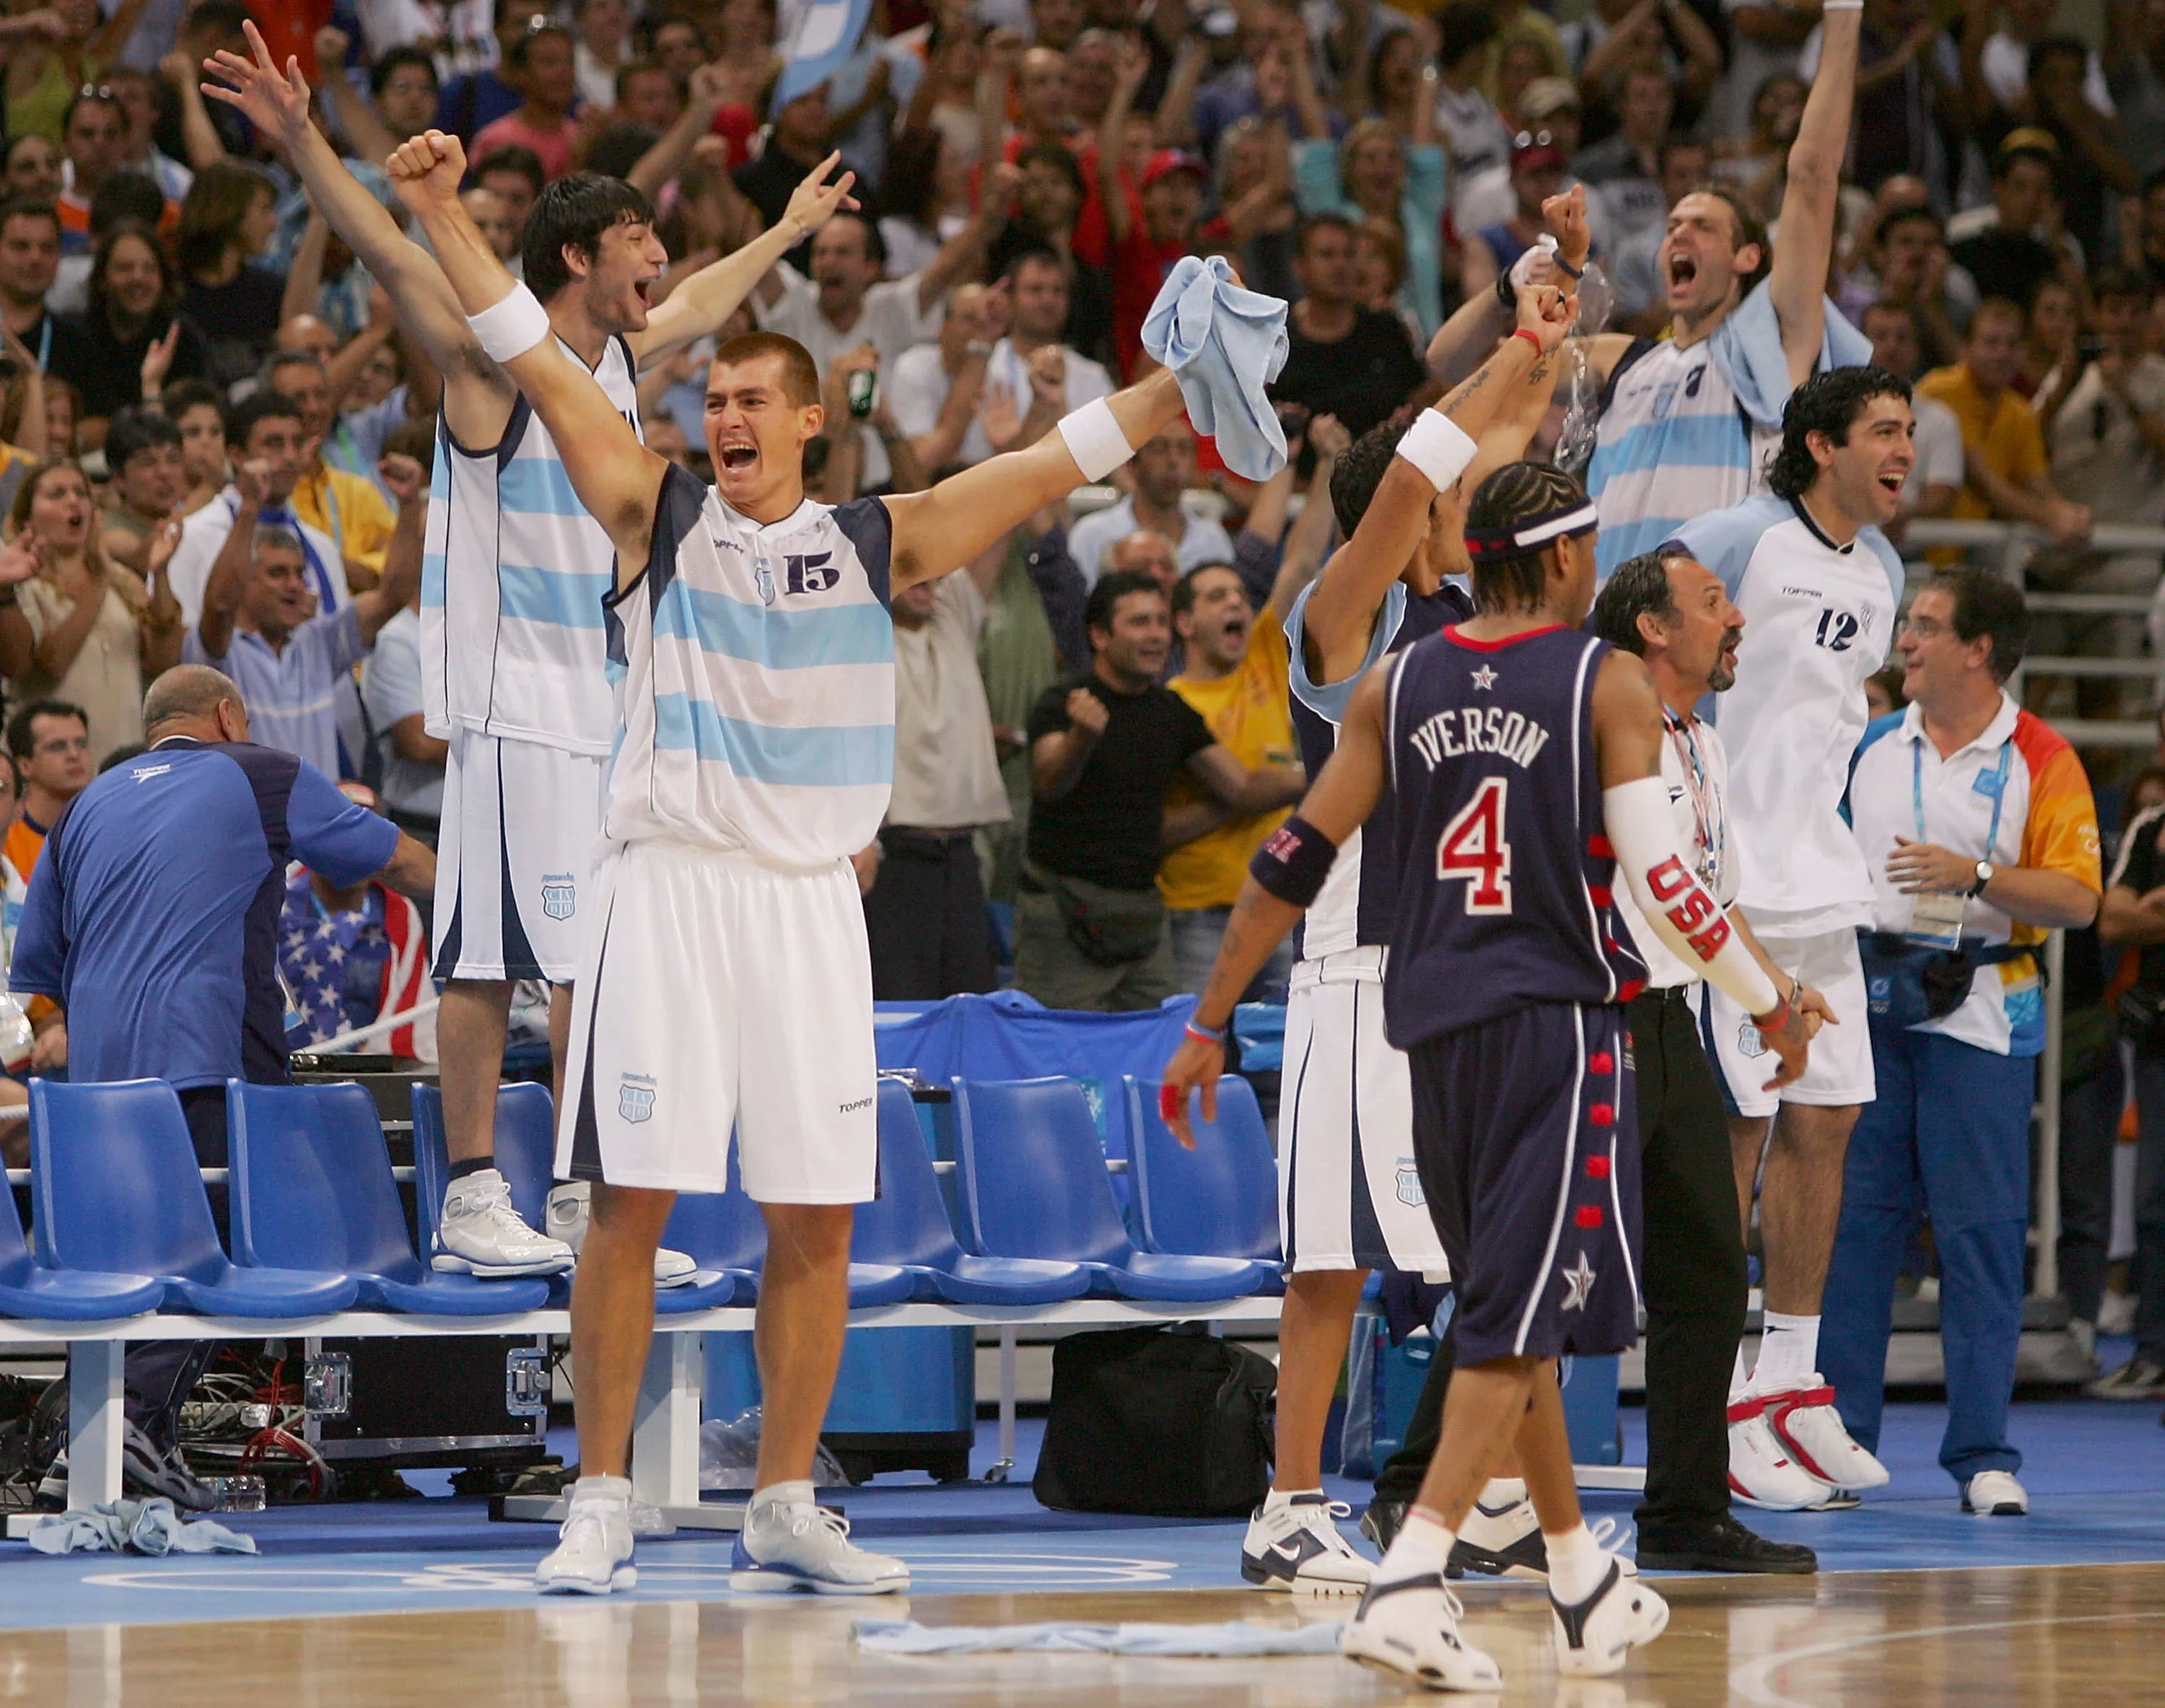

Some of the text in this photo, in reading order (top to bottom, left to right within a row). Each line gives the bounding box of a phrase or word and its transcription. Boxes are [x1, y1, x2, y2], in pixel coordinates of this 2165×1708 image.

[1685, 364, 1707, 398] 7
[782, 551, 840, 595] 15
[1815, 608, 1858, 651] 12
[1409, 706, 1549, 772] IVERSON
[1436, 776, 1512, 916] 4
[1646, 854, 1731, 963] USA
[839, 1097, 873, 1113] TOPPER
